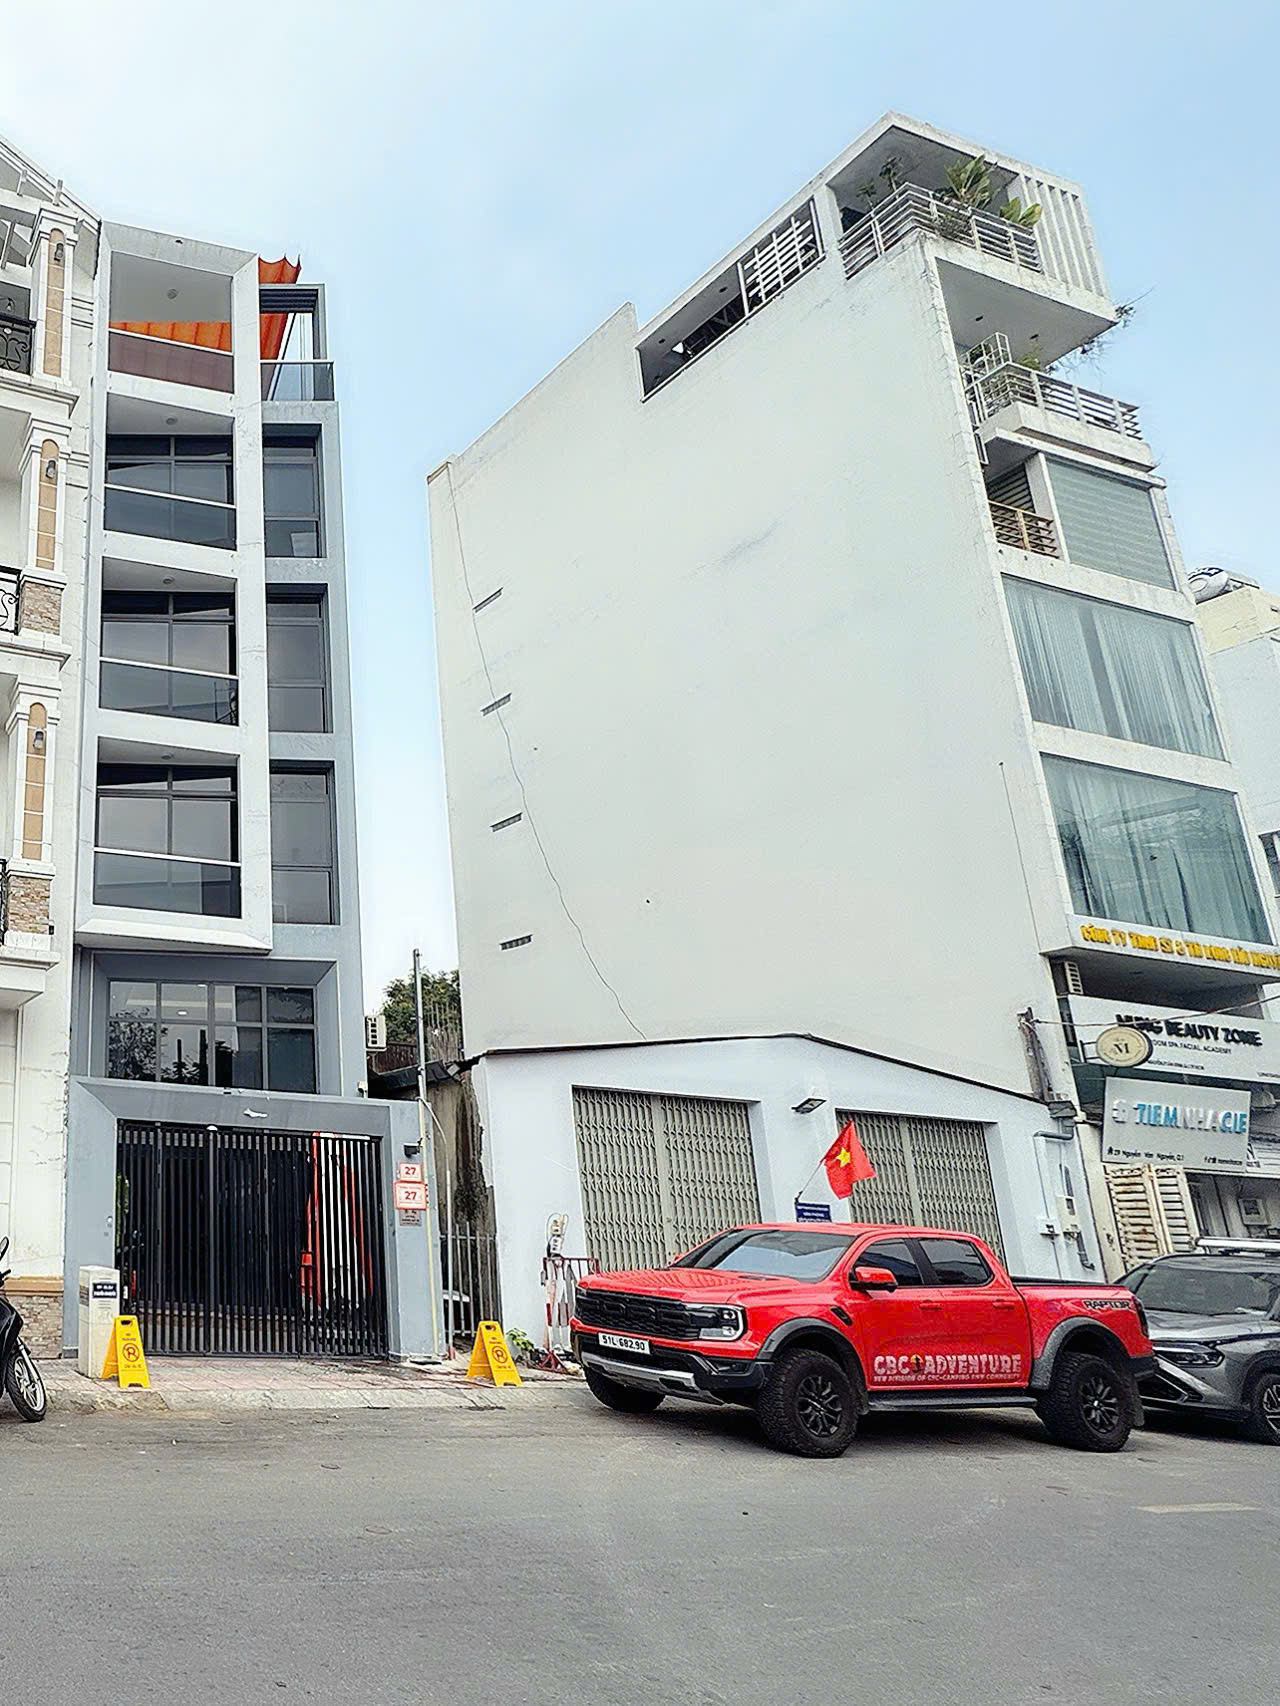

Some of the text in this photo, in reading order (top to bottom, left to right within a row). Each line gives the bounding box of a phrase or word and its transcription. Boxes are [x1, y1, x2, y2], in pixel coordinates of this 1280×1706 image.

[1164, 1019, 1220, 1042] BEAUTY
[1220, 1027, 1263, 1047] ZONE
[404, 1166, 417, 1176] 27
[404, 1190, 417, 1201] 27
[1083, 1300, 1131, 1310] RAPTOR
[873, 1353, 1022, 1375] CBC ADVENTURE
